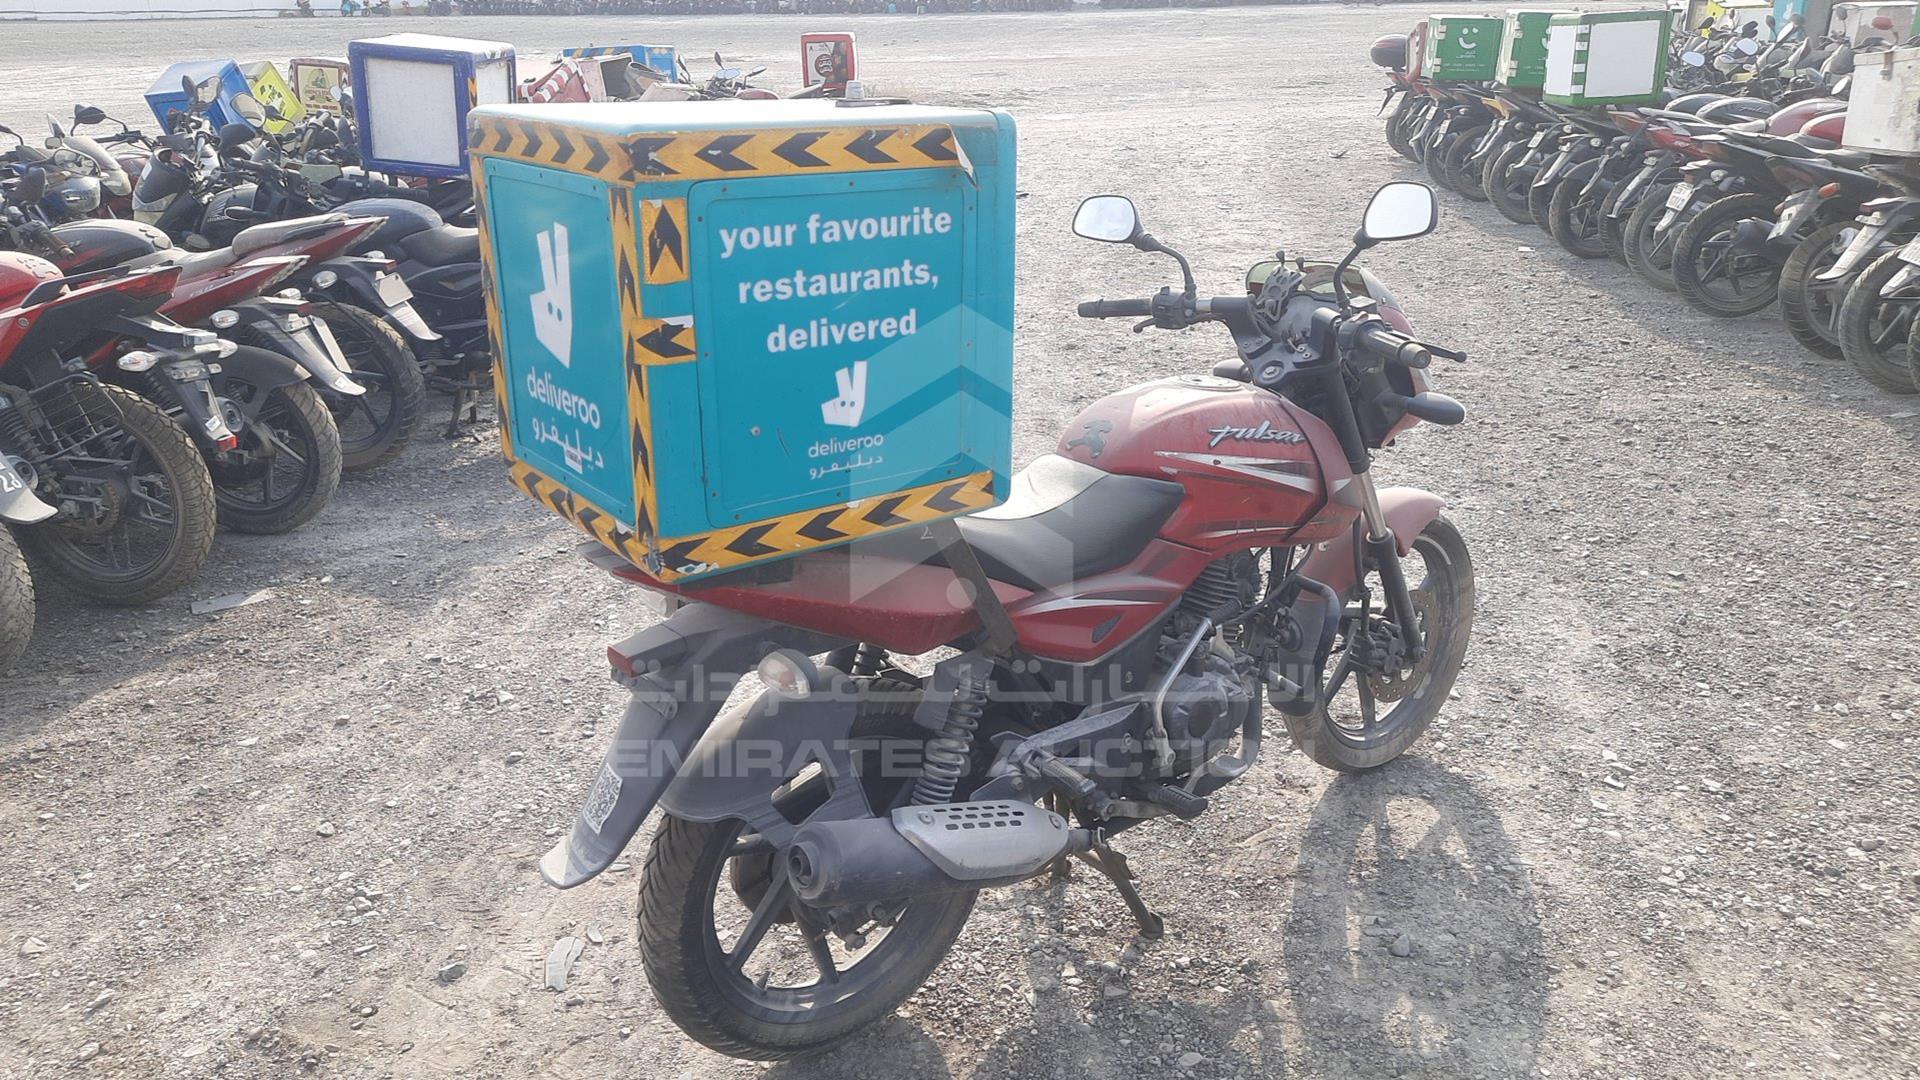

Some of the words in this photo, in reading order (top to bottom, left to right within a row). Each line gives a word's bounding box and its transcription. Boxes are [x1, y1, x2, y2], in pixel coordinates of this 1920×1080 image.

[719, 223, 797, 259] your
[807, 206, 952, 244] favourite
[739, 259, 939, 304] restaurants,
[766, 308, 917, 353] delivered
[527, 365, 601, 430] deliveroo
[808, 434, 884, 458] deliveroo
